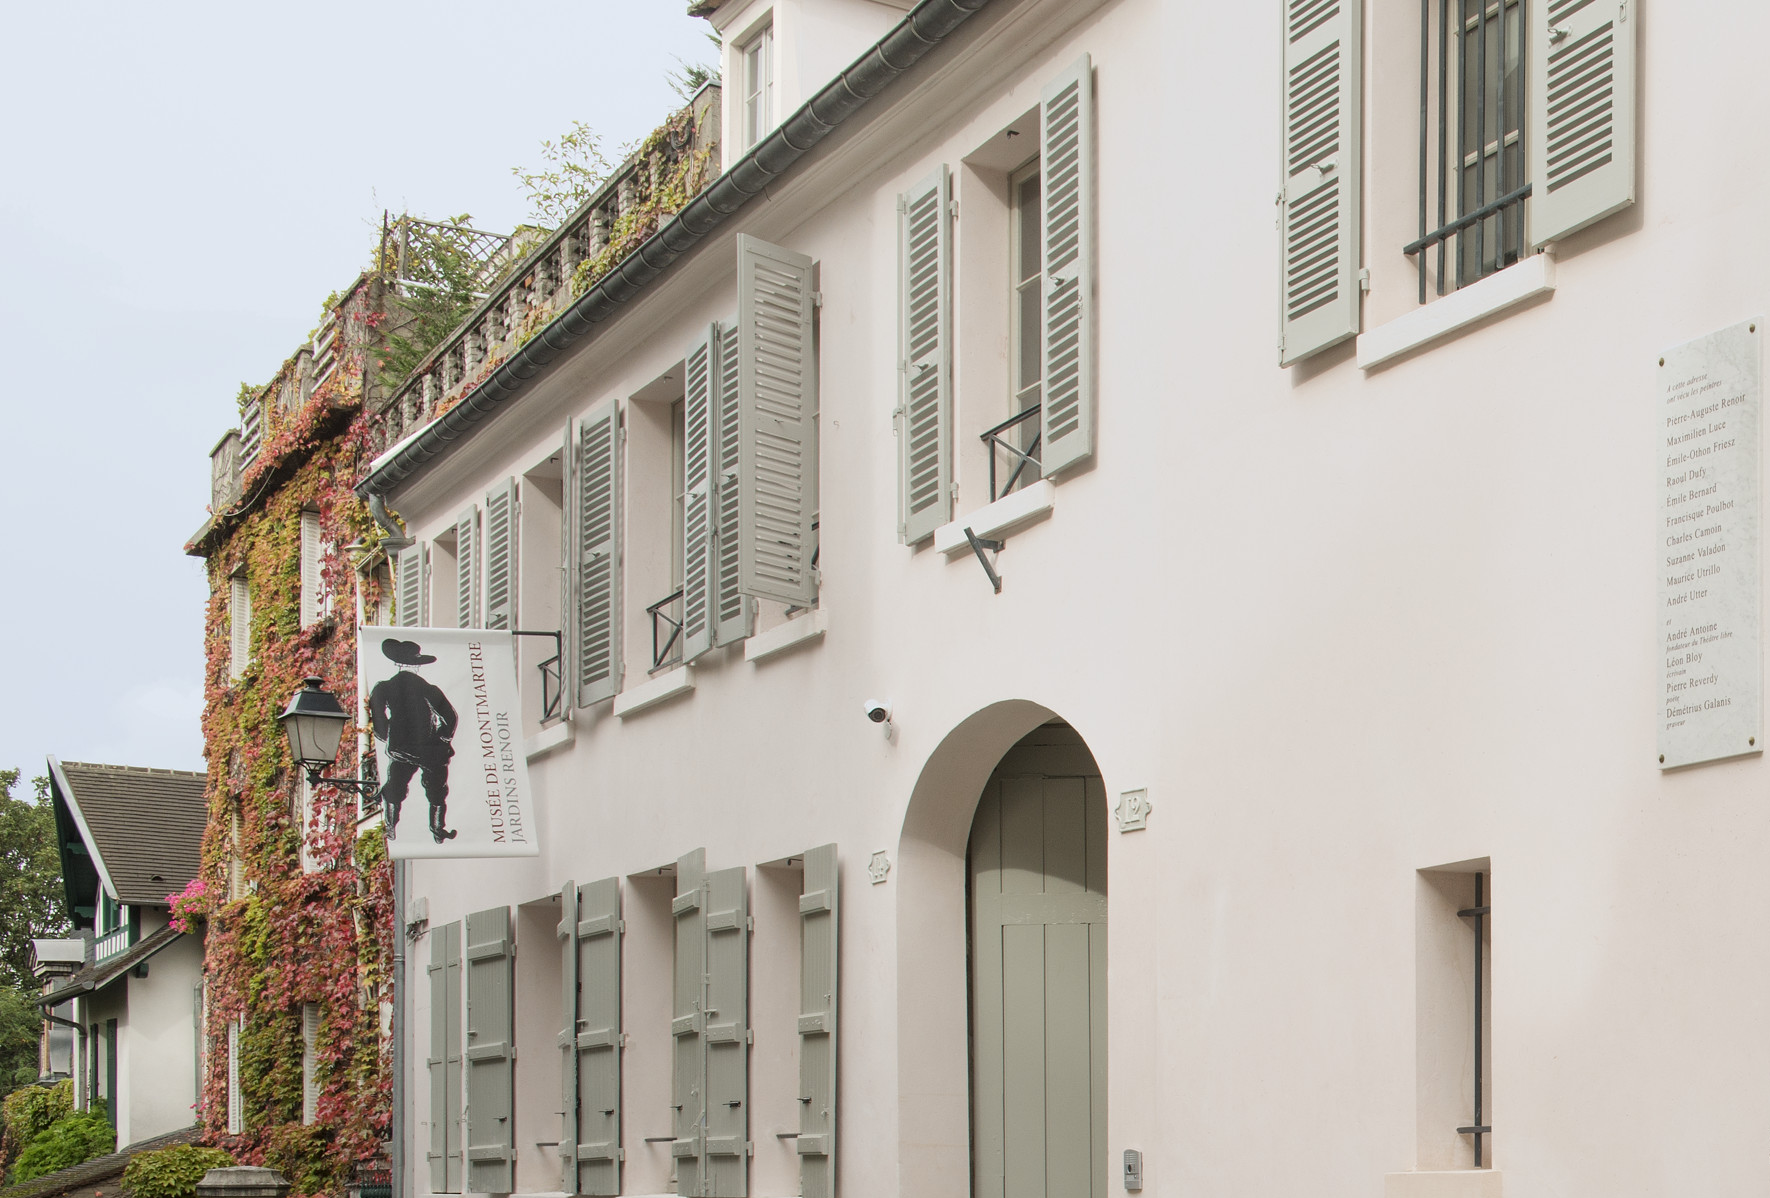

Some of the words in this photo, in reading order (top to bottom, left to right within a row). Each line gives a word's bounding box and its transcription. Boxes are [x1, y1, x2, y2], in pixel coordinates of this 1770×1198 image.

[1699, 379, 1722, 395] peintres
[1666, 402, 1719, 428] Pierre-Auguste
[1721, 391, 1746, 409] Renoir
[1666, 427, 1707, 447] Maximilien
[1708, 420, 1727, 434] Luce
[1666, 445, 1711, 468] Émile-Othon
[1713, 438, 1736, 453] Friesz
[1666, 471, 1687, 488] Raoul
[1689, 466, 1707, 480] Dufy
[1666, 492, 1687, 508] Émile
[1689, 482, 1717, 500] Bernard
[1666, 509, 1704, 528] Francisque
[1706, 499, 1734, 515] Poulbot
[1666, 531, 1693, 547] Charles
[1694, 523, 1722, 539] Camoin
[1666, 551, 1696, 568] Suzanne
[1697, 543, 1726, 558] Valadon
[1666, 571, 1695, 587] Maurice
[1696, 563, 1721, 579] Utrillo
[1666, 592, 1688, 607] André
[1689, 589, 1708, 601] Utter
[1666, 628, 1688, 643] André
[1689, 622, 1718, 637] Antoine
[1666, 656, 1684, 669] Léon
[1686, 651, 1703, 664] Bloy
[1666, 681, 1687, 693] Pierre
[1689, 673, 1719, 689] Reverdy
[468, 641, 496, 759] MONTMARTRE
[1666, 703, 1702, 719] Démétrius
[1703, 695, 1732, 710] Galanis
[495, 711, 516, 773] RENOIR
[484, 762, 499, 788] DE
[487, 789, 506, 844] MUSÉE
[503, 776, 528, 845] JARDINS
